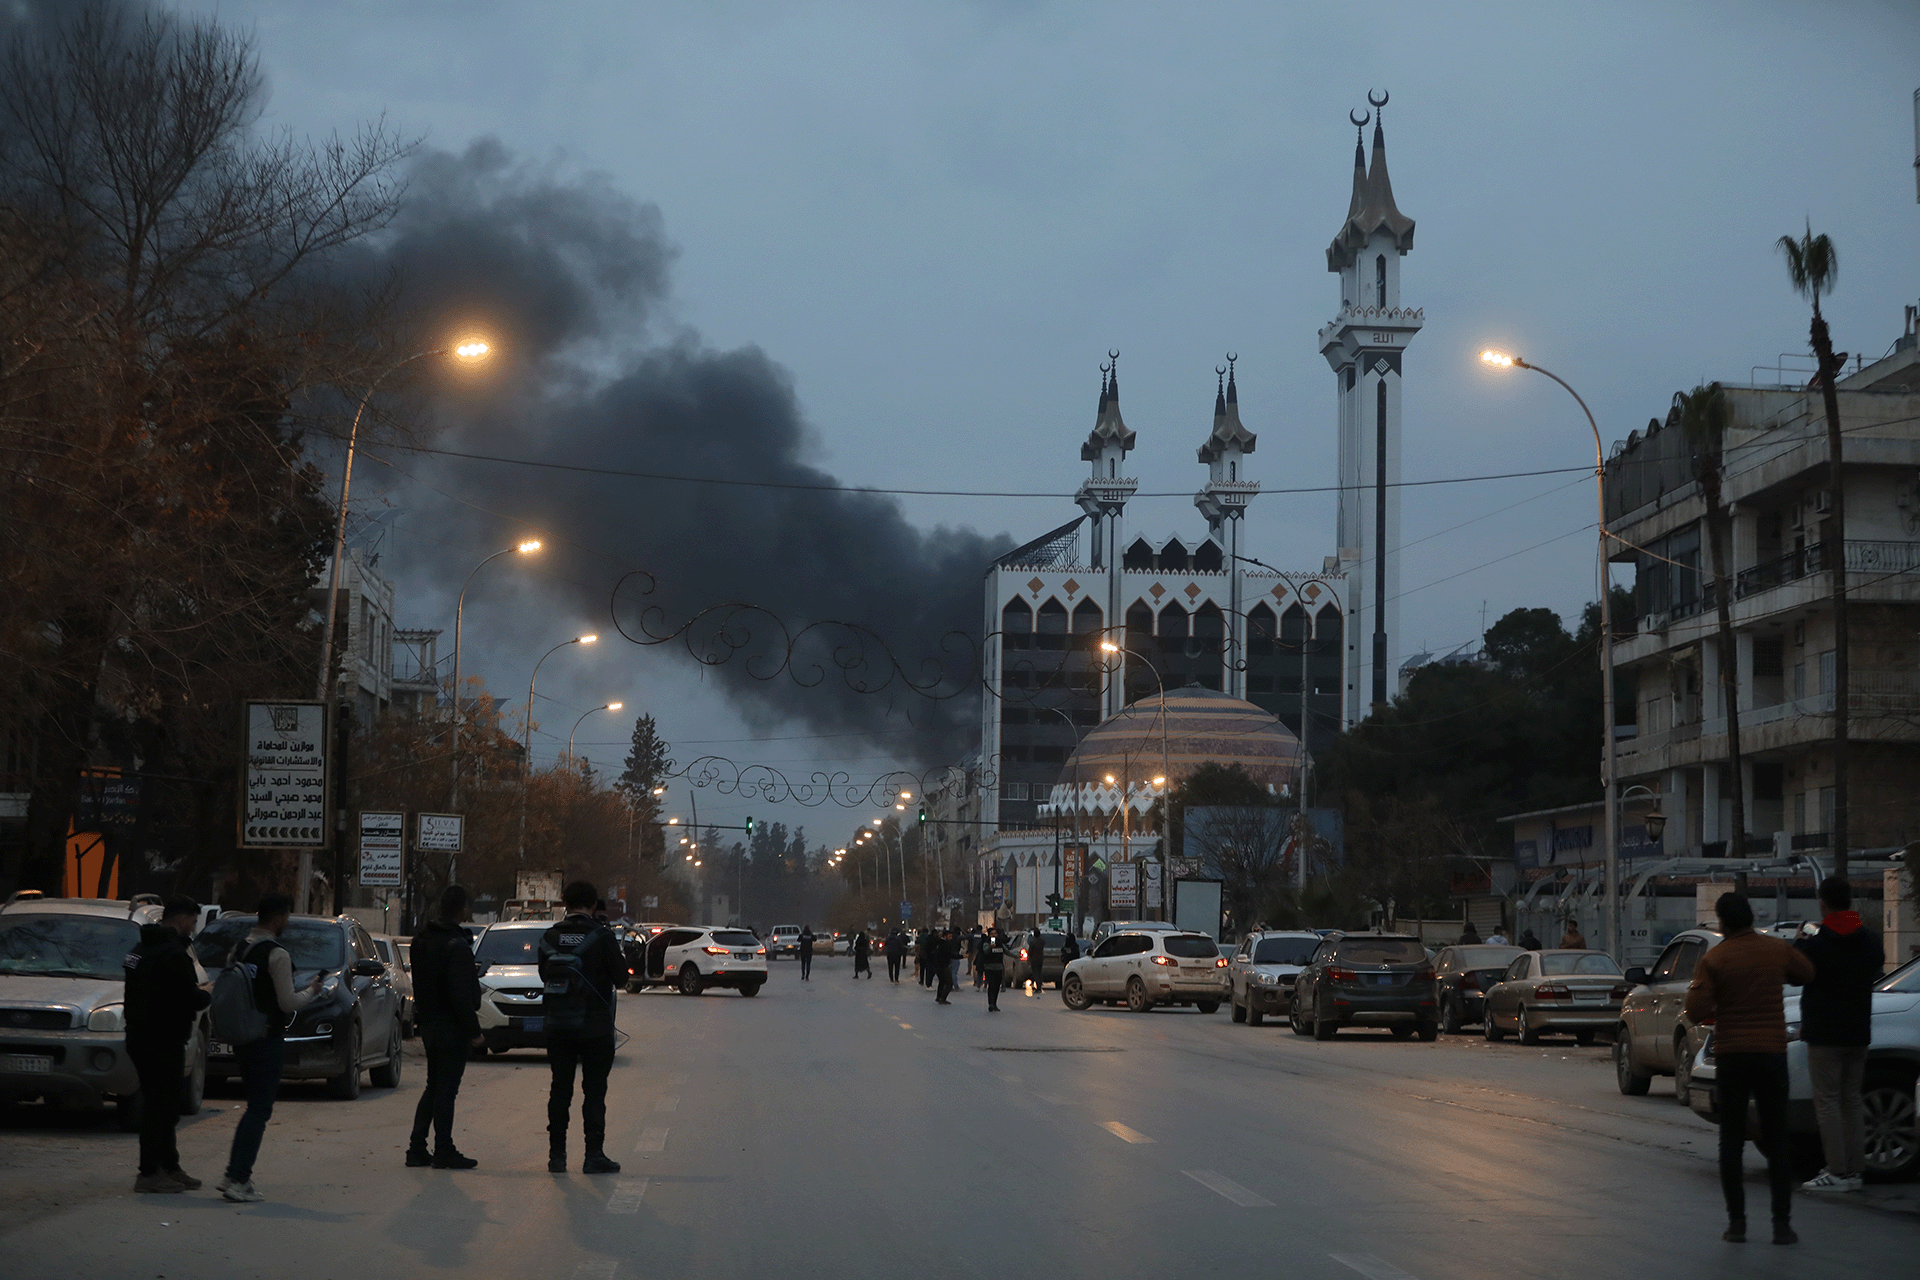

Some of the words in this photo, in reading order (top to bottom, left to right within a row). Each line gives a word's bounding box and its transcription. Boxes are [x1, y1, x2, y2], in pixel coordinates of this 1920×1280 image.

[1373, 333, 1394, 344] الله
[1102, 490, 1124, 501] الله
[1224, 493, 1246, 504] الله
[257, 740, 287, 751] للمحاماة
[290, 741, 314, 752] موازين
[249, 756, 275, 766] القانونية
[276, 756, 322, 767] والاستشارات
[270, 774, 291, 786] أحمد
[295, 777, 322, 787] محمود
[249, 791, 272, 803] السيد
[275, 794, 300, 807] صبحي
[303, 793, 322, 804] محمد
[247, 808, 278, 822] صوراني
[280, 808, 306, 820] الرحمن
[307, 809, 322, 820] عبد
[560, 934, 585, 944] PRESS
